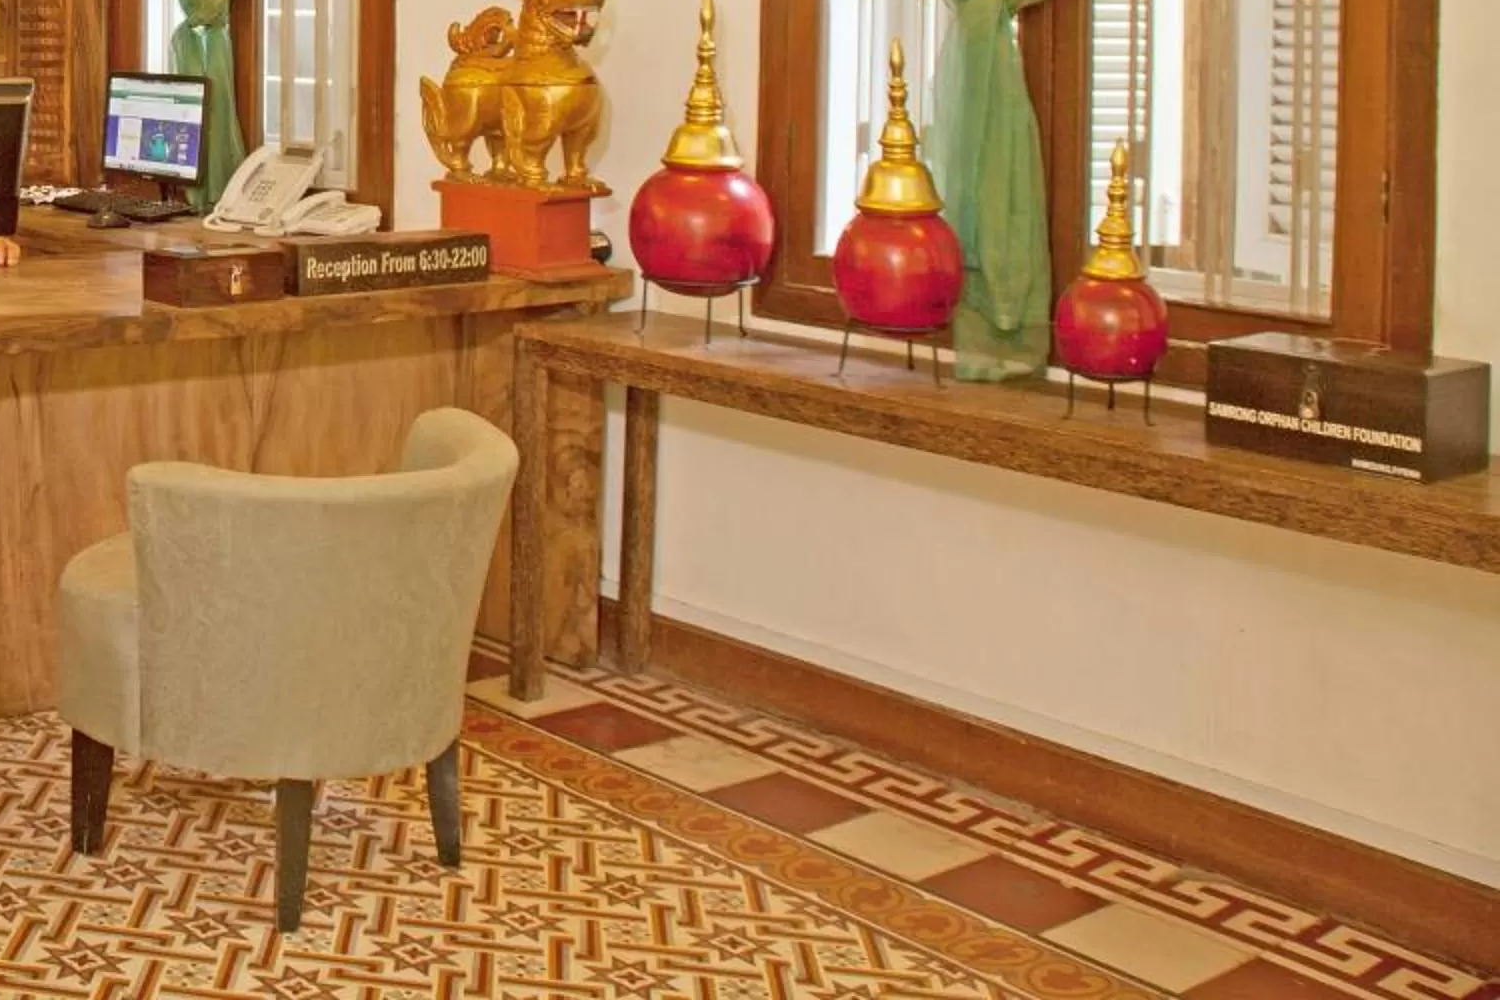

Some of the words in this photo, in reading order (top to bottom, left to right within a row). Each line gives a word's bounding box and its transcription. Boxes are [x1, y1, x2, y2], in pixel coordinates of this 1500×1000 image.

[307, 253, 377, 282] Reception
[381, 251, 415, 274] From
[419, 246, 487, 271] 6:30-22:00
[1258, 409, 1300, 431] ORPHAN
[1301, 418, 1351, 441] CHILDREN
[1353, 426, 1422, 453] FOUNDATION
